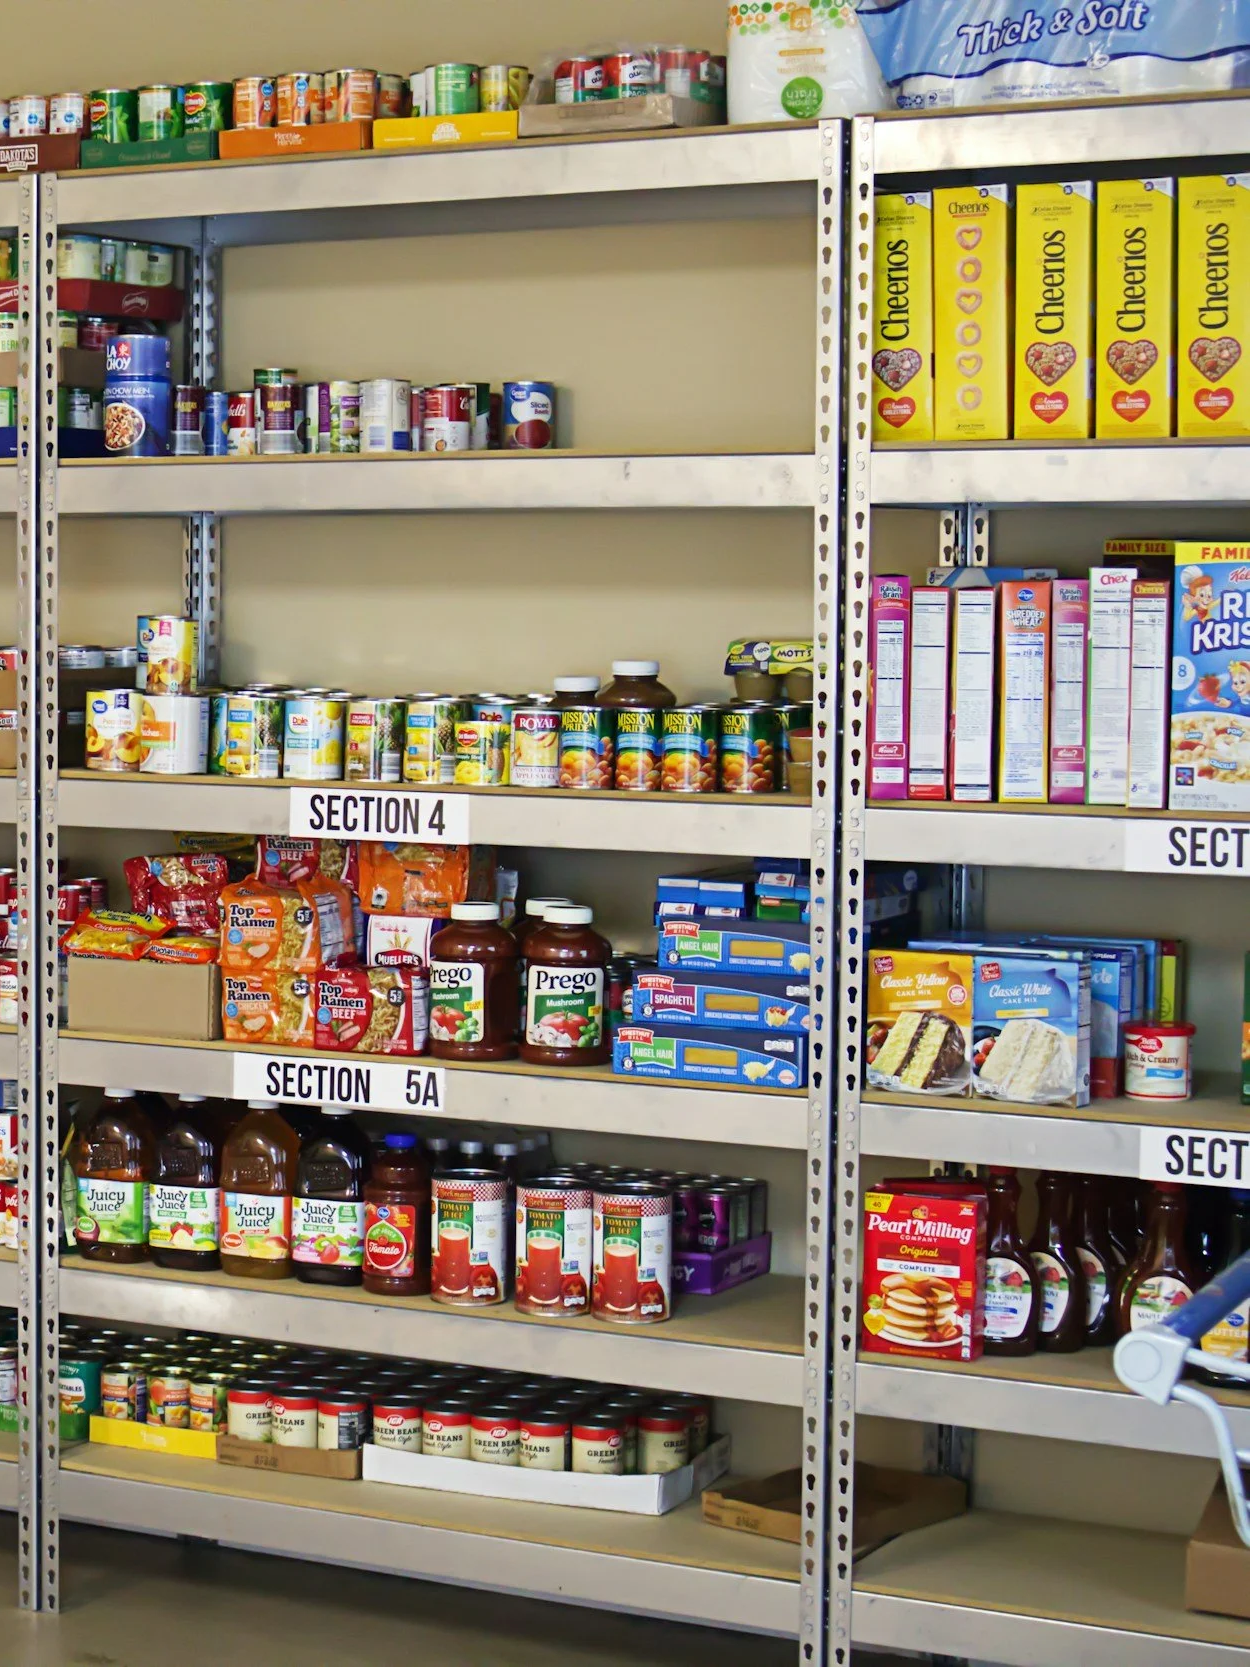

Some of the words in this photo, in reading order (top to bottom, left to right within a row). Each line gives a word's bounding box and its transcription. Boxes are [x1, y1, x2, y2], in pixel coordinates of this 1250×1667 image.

[959, 21, 1041, 56] Thick
[1050, 15, 1074, 33] &
[1076, 0, 1147, 36] Soft
[0, 148, 36, 162] DAKOTA'S
[949, 201, 988, 213] Cheerios
[1035, 229, 1065, 334] Cheerios
[1117, 226, 1146, 332] Cheerios
[1198, 222, 1229, 329] Cheerios
[881, 239, 909, 341] Cheerios
[106, 345, 116, 357] LA
[106, 357, 131, 370] CHOY
[132, 387, 151, 395] MEIN
[530, 401, 549, 409] Sliced
[1106, 543, 1142, 552] FAMILY
[1145, 543, 1167, 552] SIZE
[1202, 548, 1250, 560] FAMIL
[1101, 573, 1127, 585] Chex
[880, 585, 902, 594] Raisin
[883, 590, 900, 598] Bran
[1222, 592, 1250, 618] RI
[1006, 610, 1044, 619] SHREDDED
[1191, 621, 1250, 651] KRIS
[1177, 665, 1187, 677] 8
[519, 717, 555, 730] ROYAL
[562, 713, 598, 730] MISSION
[618, 714, 654, 730] MISSION
[665, 714, 701, 730] MISSION
[566, 724, 590, 733] PRIDE
[623, 725, 646, 733] PRIDE
[669, 725, 693, 733] PRIDE
[310, 794, 419, 835] SECTION
[428, 800, 445, 835] 4
[266, 839, 312, 850] Ramen
[1169, 827, 1250, 867] SECT
[280, 851, 303, 860] BEEF
[230, 905, 254, 918] Top
[230, 916, 274, 928] Ramen
[679, 941, 699, 950] ANGEL
[702, 942, 719, 952] HAIR
[378, 954, 418, 965] MUELLER'S
[431, 967, 472, 989] Prego
[535, 971, 596, 994] Prego
[881, 975, 915, 989] Classic
[917, 974, 948, 986] Yellow
[226, 979, 246, 992] Top
[320, 982, 341, 996] Top
[990, 985, 1021, 998] Classic
[1023, 982, 1051, 995] White
[228, 990, 270, 1000] Ramen
[321, 994, 364, 1008] Ramen
[655, 994, 693, 1005] SPAGHETTI
[238, 1002, 268, 1011] CHICKEN
[546, 999, 584, 1007] Mushroom
[332, 1009, 356, 1019] BEEF
[634, 1048, 654, 1057] ANGEL
[657, 1049, 673, 1058] HAIR
[1148, 1054, 1179, 1065] Creamy
[266, 1062, 370, 1104] SECTION
[406, 1069, 440, 1108] 5A
[1166, 1136, 1250, 1180] SECT
[87, 1189, 125, 1203] Juicy
[156, 1188, 188, 1202] Juicy
[89, 1201, 120, 1211] Juice
[159, 1199, 185, 1209] Juice
[302, 1202, 336, 1216] Juicy
[440, 1204, 469, 1212] TOMATO
[235, 1205, 274, 1221] Juicy
[304, 1214, 333, 1224] Juice
[444, 1211, 464, 1219] JUICE
[529, 1212, 561, 1221] TOMATO
[238, 1216, 270, 1227] Juice
[533, 1220, 555, 1228] JUICE
[605, 1219, 637, 1227] TOMATO
[610, 1226, 631, 1235] JUICE
[868, 1215, 911, 1234] Pearl
[914, 1220, 972, 1244] Milling
[369, 1243, 399, 1255] Tomato
[900, 1245, 938, 1257] Original
[899, 1264, 935, 1272] COMPLETE
[437, 1434, 462, 1442] BEANS
[474, 1439, 498, 1448] GREEN
[588, 1449, 614, 1457] GREEN
